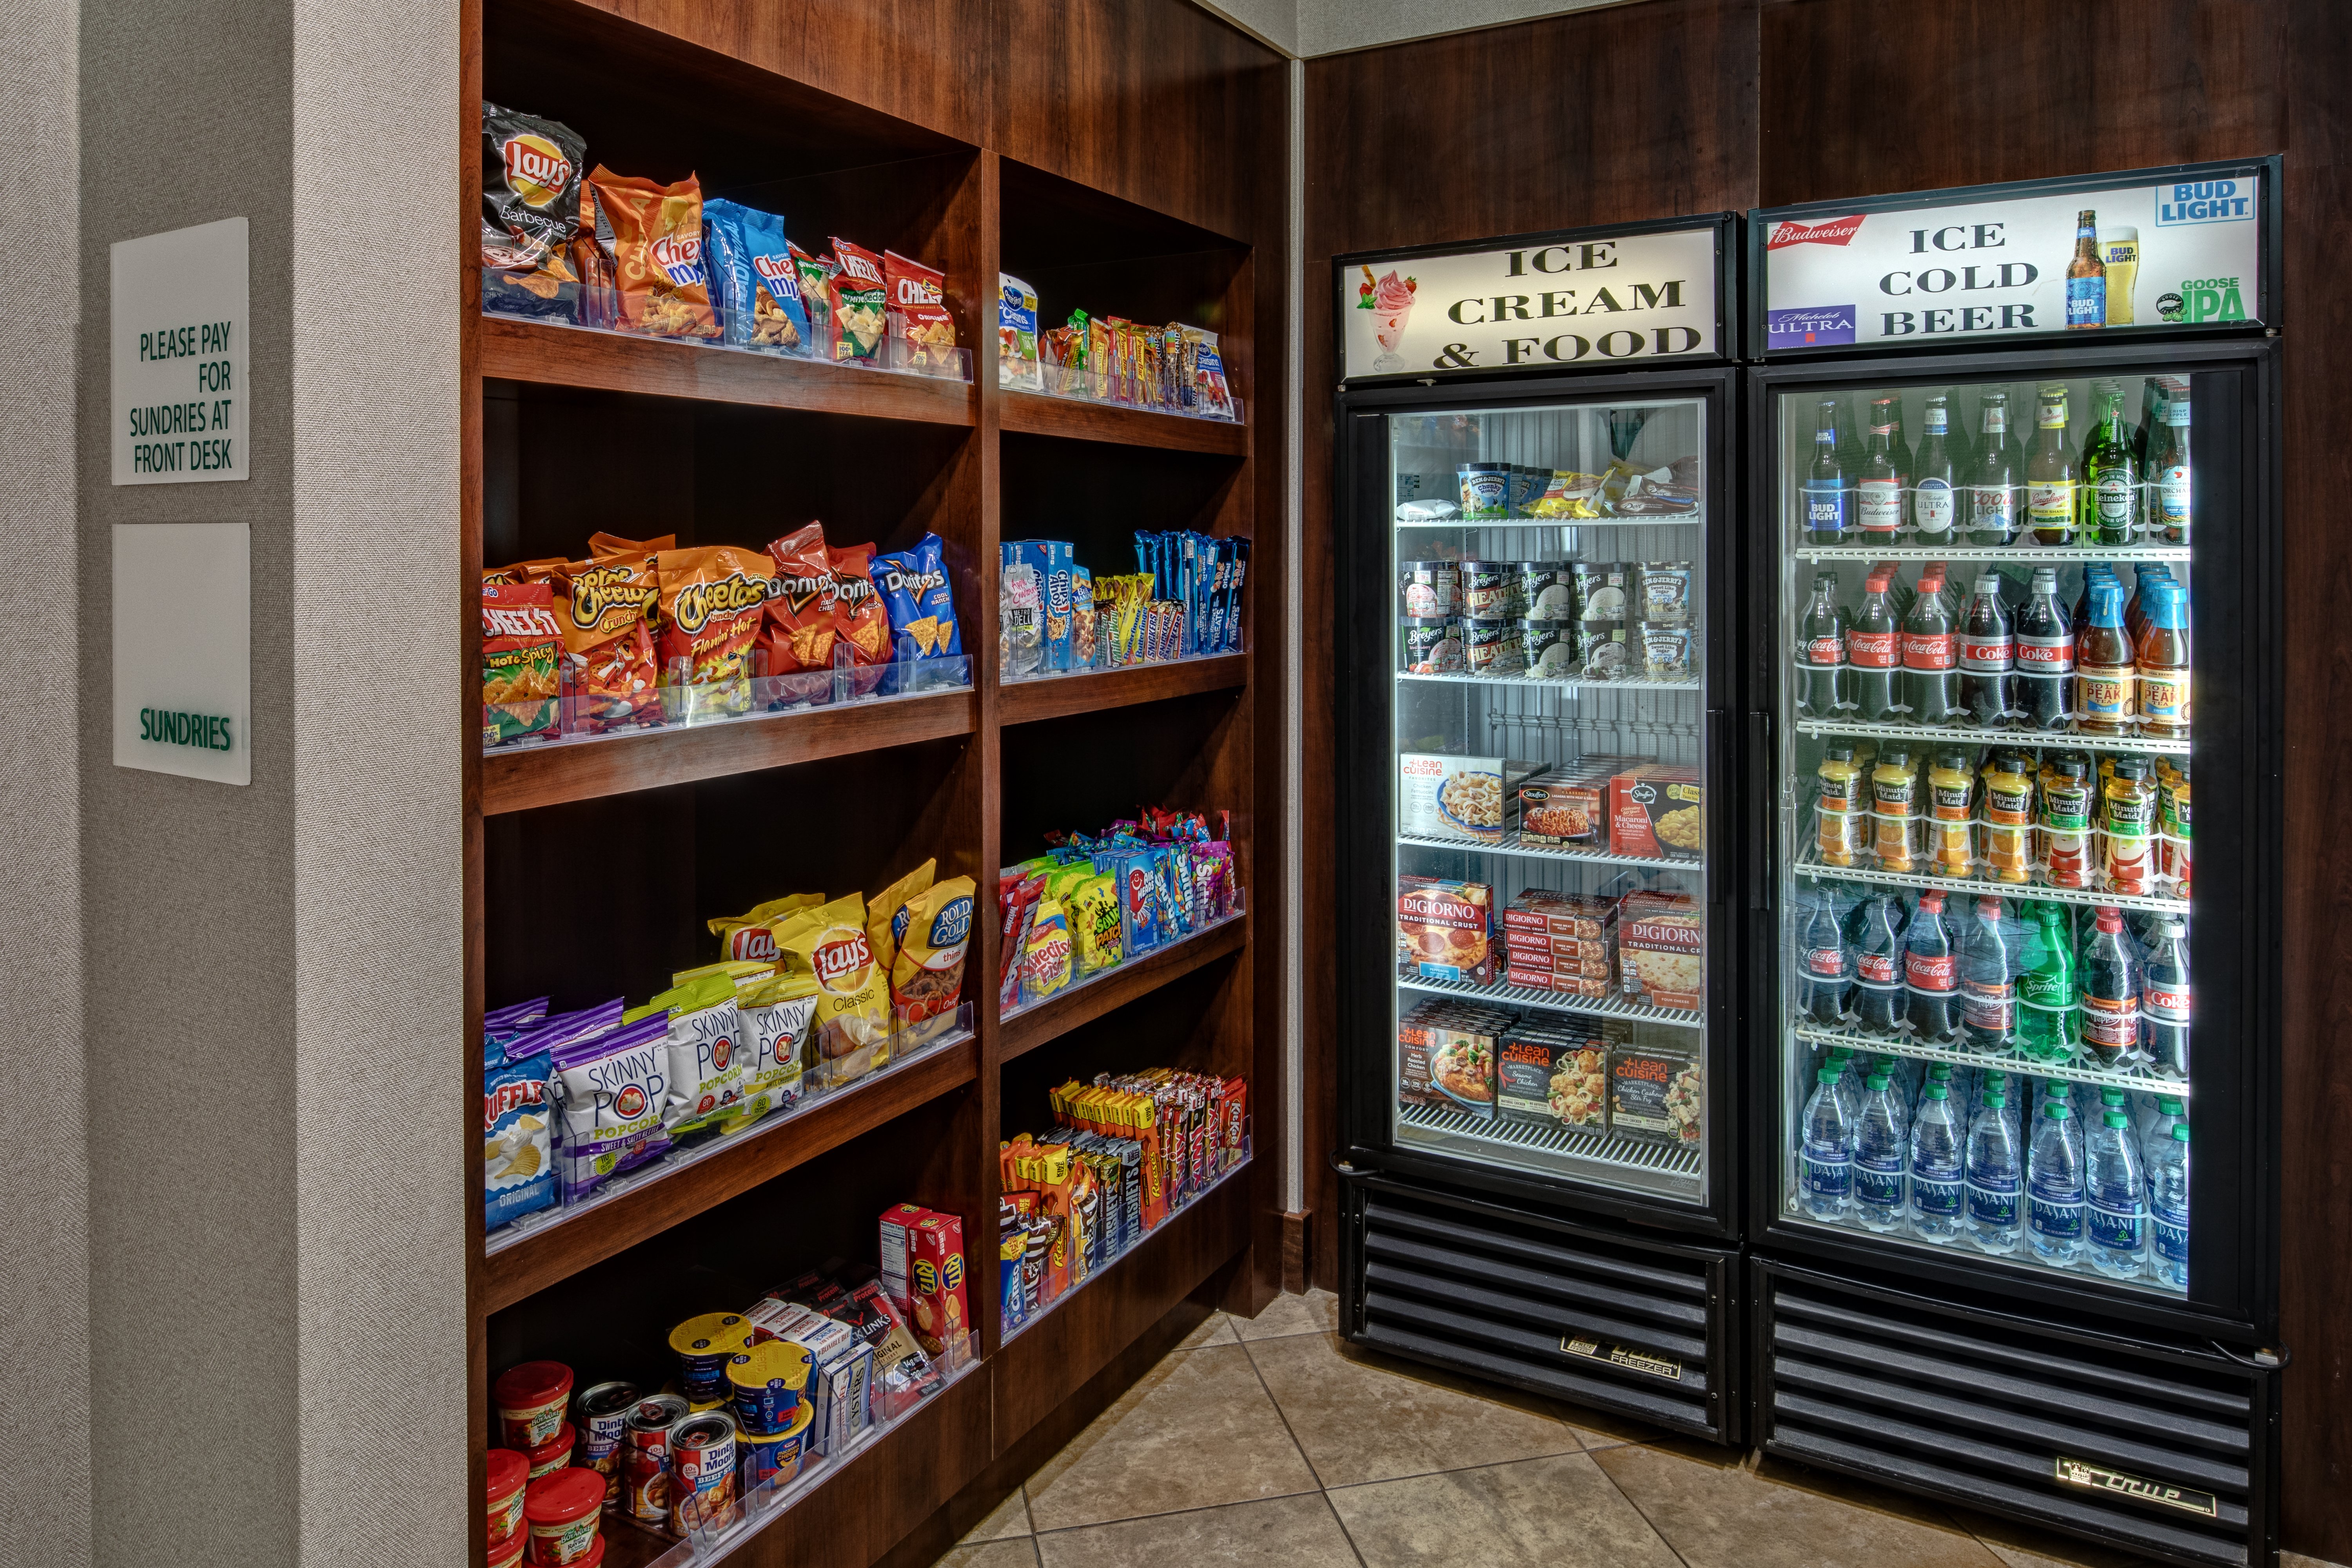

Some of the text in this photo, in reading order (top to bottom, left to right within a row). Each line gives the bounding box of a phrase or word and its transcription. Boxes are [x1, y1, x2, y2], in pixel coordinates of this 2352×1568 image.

[511, 143, 569, 188] Lay's
[2174, 180, 2236, 202] BUD
[2162, 198, 2249, 221] LIGHT
[501, 205, 566, 232] Barbecue
[550, 229, 566, 240] Flavored
[677, 230, 700, 240] SAVORY
[1772, 225, 1859, 243] Budweiser
[1909, 223, 2005, 254] ICE
[1504, 241, 1618, 277] ICE
[2106, 254, 2136, 263] LIGHT
[2111, 247, 2133, 256] BUD
[1879, 263, 2038, 296] COLD
[2181, 278, 2239, 290] GOOSE
[1448, 280, 1686, 325] CREAM
[2069, 306, 2099, 315] LIGHT
[2071, 299, 2094, 309] BUD
[2182, 288, 2246, 323] IPA
[1778, 312, 1841, 321] Michelob
[1880, 304, 2038, 336] BEER
[1768, 319, 1854, 333] ULTRA
[140, 321, 231, 362] PLEASE PAY
[1433, 327, 1701, 369] & FOOD
[199, 361, 231, 393] FOR
[130, 400, 231, 437] SUNDRIES AT
[135, 439, 232, 474] FRONT DESK
[2094, 493, 2136, 503] Heineken
[1809, 511, 1839, 520] LIGHT
[1811, 503, 1835, 513] BUD
[1860, 506, 1899, 515] Budweiser
[767, 573, 833, 598] Doritos
[886, 570, 944, 592] Doritos
[1469, 574, 1499, 588] Breyers
[677, 578, 766, 633] Cheetos
[710, 610, 737, 622] Crunchy
[1015, 615, 1030, 625] DELI
[730, 617, 757, 636] Hot
[1062, 614, 1071, 641] ORIGINAL
[1147, 613, 1157, 658] SNICKERS
[1408, 628, 1442, 644] Breyers
[1469, 629, 1499, 643] Breyers
[1808, 638, 1844, 652] Coca-Cola
[1854, 639, 1892, 653] Coca-Cola
[1908, 641, 1947, 654] Coca-Cola
[1975, 646, 2009, 660] Coke
[2020, 646, 2054, 661] Coke
[2087, 689, 2121, 699] PEAK
[2145, 690, 2178, 701] PEAK
[140, 708, 230, 751] SUNDRIES
[1875, 783, 1906, 793] Minute
[1880, 791, 1901, 800] Maid
[2049, 795, 2081, 806] Minute
[2053, 804, 2076, 813] Maid
[2110, 803, 2143, 813] Minute
[1614, 815, 1648, 824] Macaroni
[1144, 870, 1154, 885] AIR
[1138, 882, 1154, 902] HEADS
[941, 897, 970, 924] ROLD
[1399, 915, 1450, 926] TRADITIONAL
[936, 914, 971, 946] GOLD
[1628, 941, 1681, 953] TRADITIONAL
[820, 936, 870, 982] Lay's
[942, 948, 961, 963] thins
[1857, 953, 1895, 970] Coca-Cola
[1036, 959, 1065, 985] Fish
[1912, 960, 1951, 976] Coca-Cola
[2026, 980, 2058, 991] Sprite
[833, 988, 875, 1013] Classic
[2151, 992, 2190, 1008] Coke
[757, 1003, 805, 1036] SKINNY
[588, 1051, 659, 1093] SKINNY
[1512, 1070, 1532, 1079] Sesame
[1516, 1078, 1538, 1087] Chicken
[1617, 1085, 1664, 1098] Chicken Cashew
[594, 1074, 665, 1127] POP
[1856, 1169, 1897, 1187] DASANI
[499, 1183, 539, 1207] ORIGINAL
[1916, 1180, 1959, 1196] DASANI
[2035, 1201, 2080, 1220] DASANI
[853, 1285, 878, 1303] Protein
[1011, 1264, 1020, 1312] OREO
[866, 1314, 891, 1338] LINK'S
[1611, 1354, 1672, 1375] FREEZER
[708, 1440, 734, 1461] Dinty
[706, 1449, 735, 1472] Moore
[697, 1473, 721, 1485] BEEF
[567, 1537, 586, 1550] Ravioli
